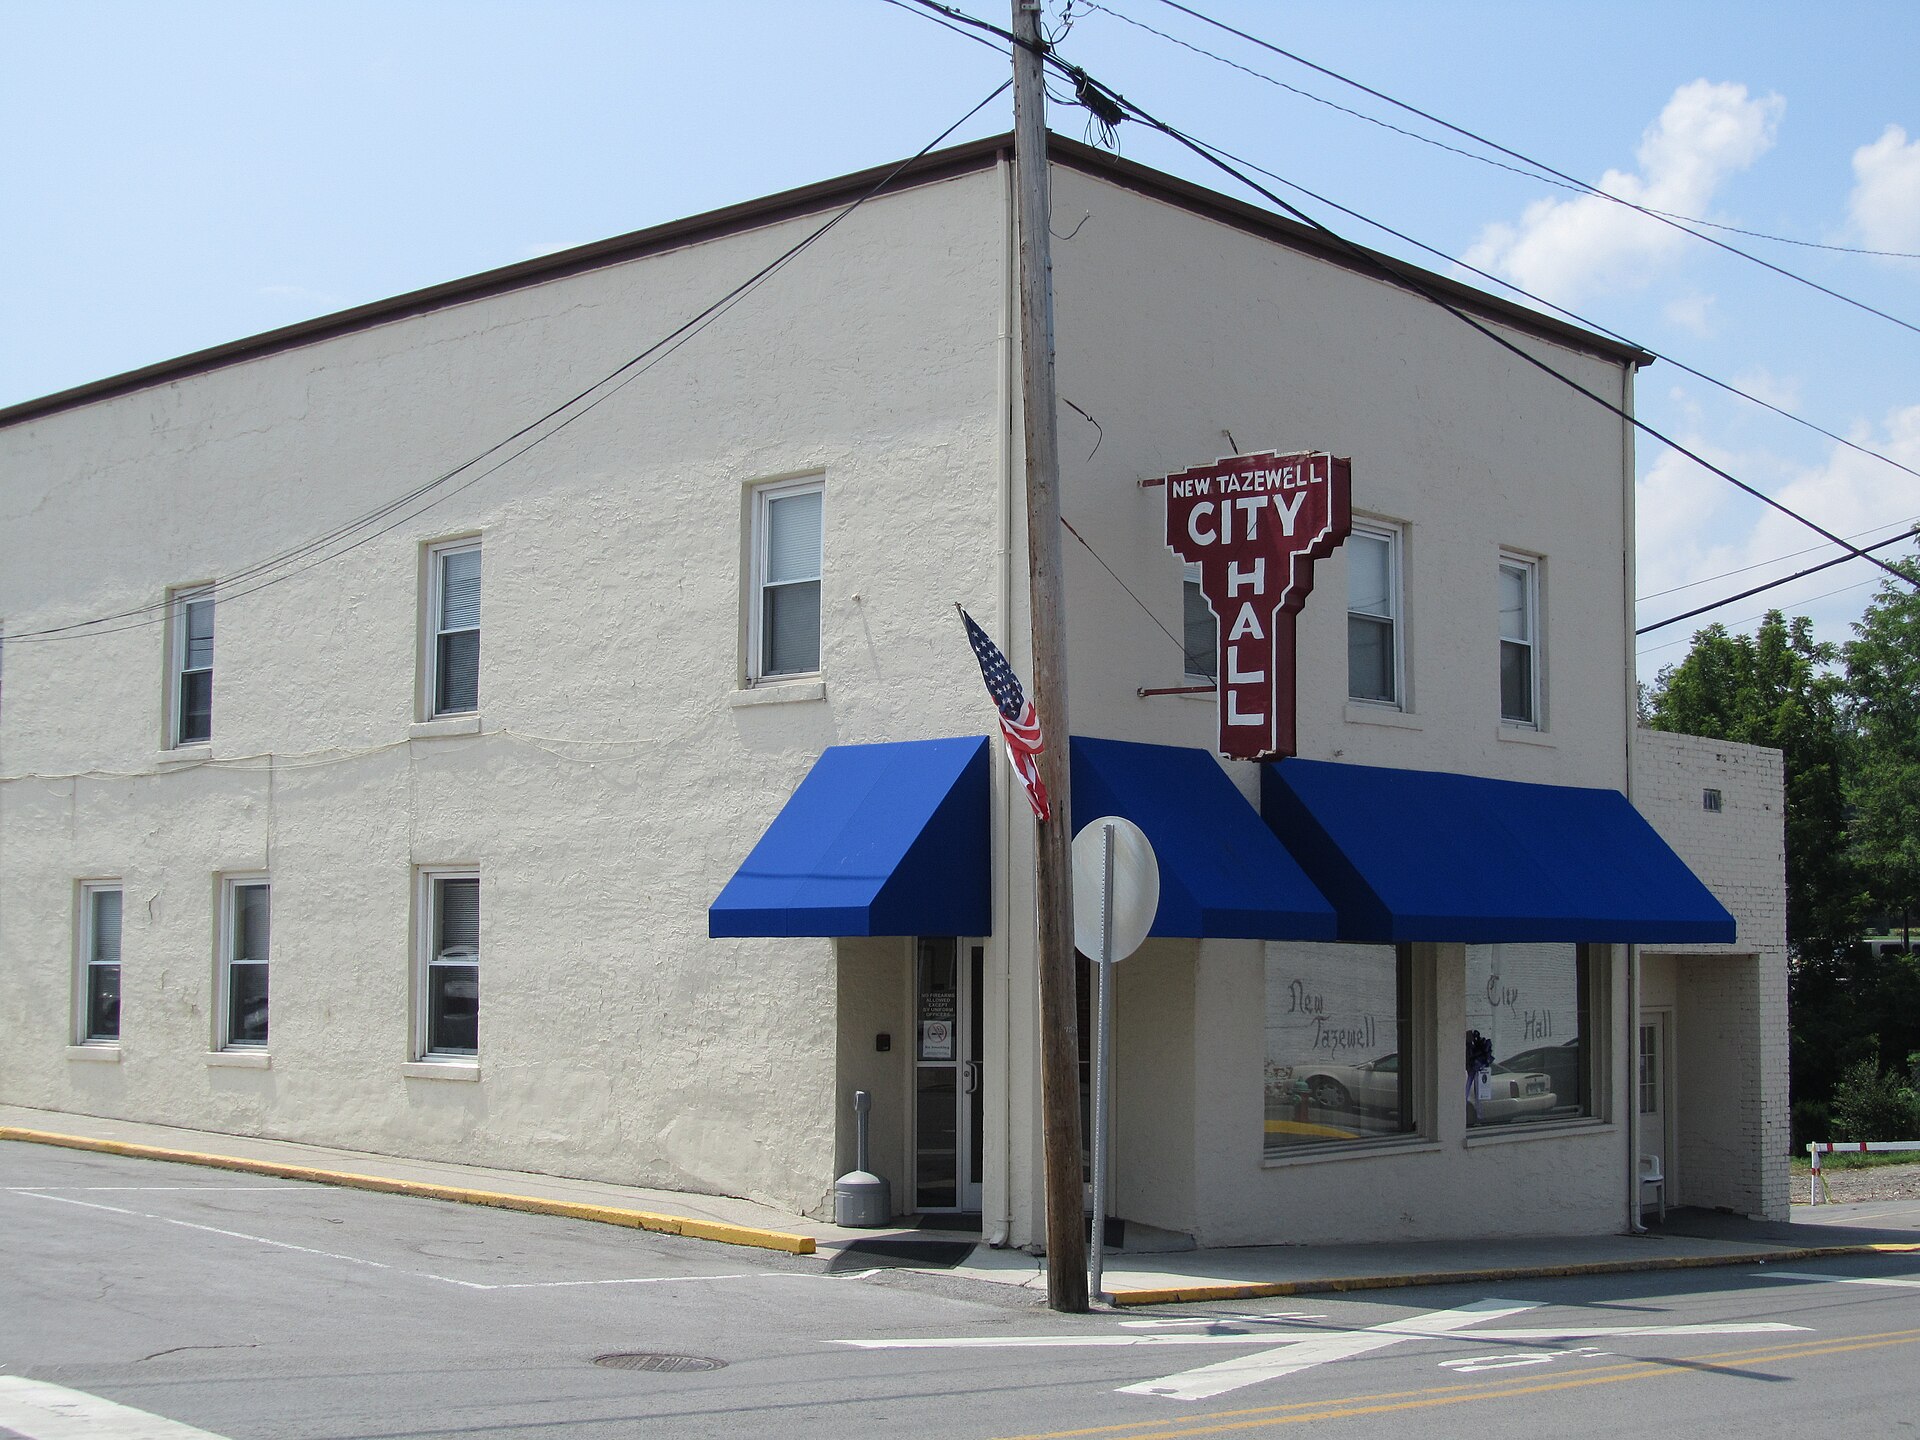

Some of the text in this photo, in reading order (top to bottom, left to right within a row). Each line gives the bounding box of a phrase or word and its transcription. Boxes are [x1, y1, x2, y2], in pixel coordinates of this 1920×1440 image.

[1172, 463, 1322, 499] NEW TAZEWELL
[1187, 491, 1307, 546] CITY
[1227, 557, 1265, 726] HALL
[1287, 979, 1323, 1014] New
[1487, 974, 1518, 1020] City
[1311, 1014, 1375, 1060] Tazewell
[1524, 1009, 1551, 1041] Hall
